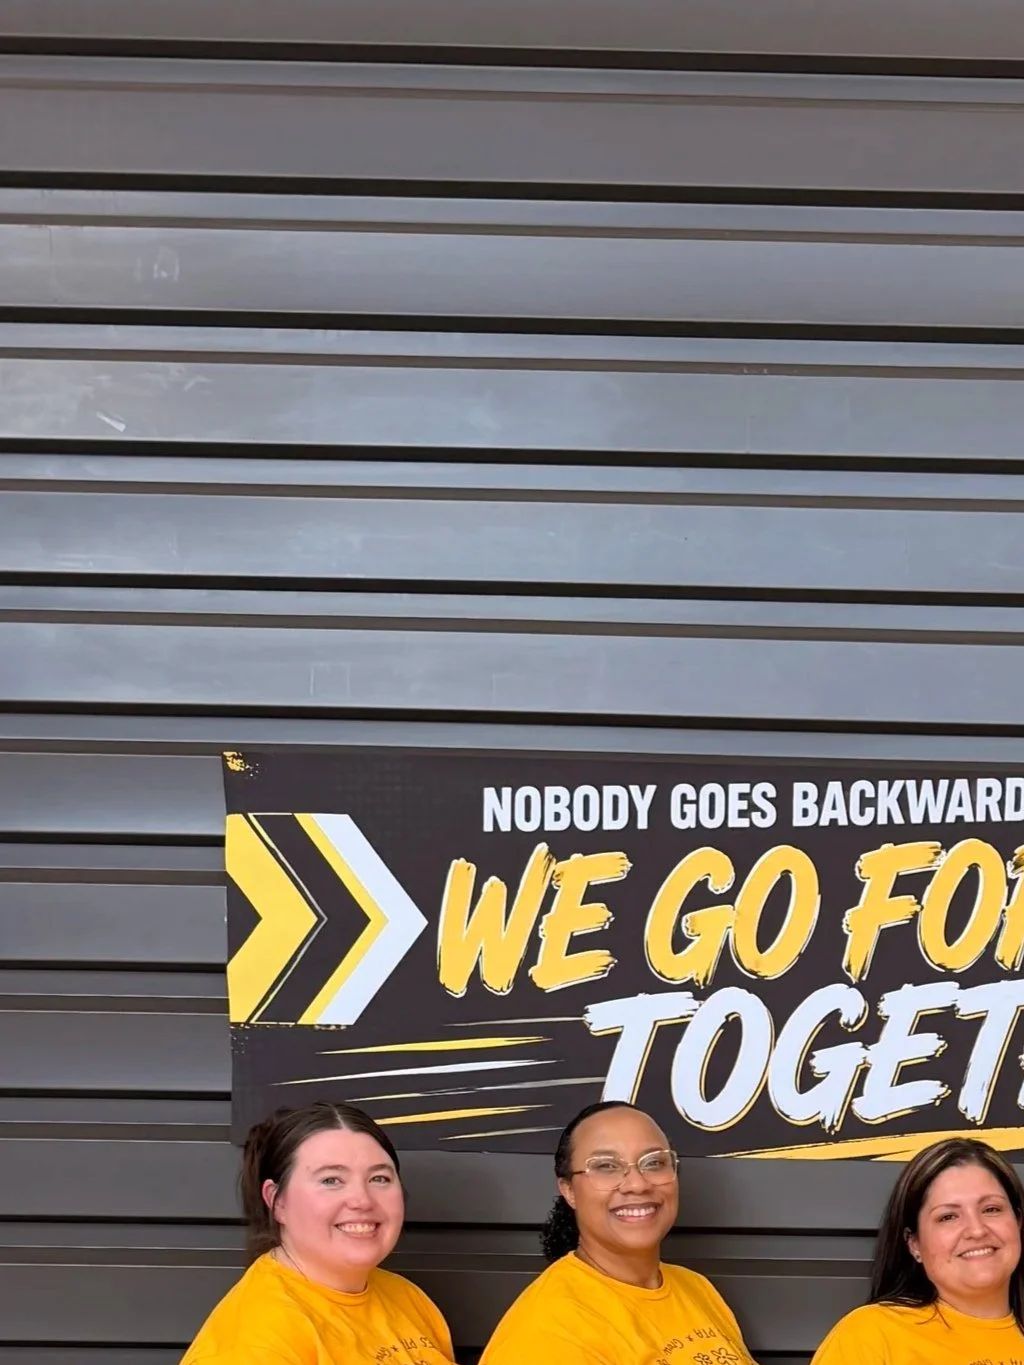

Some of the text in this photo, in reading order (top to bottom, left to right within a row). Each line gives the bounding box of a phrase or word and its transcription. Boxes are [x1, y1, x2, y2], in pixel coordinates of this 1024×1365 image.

[483, 784, 657, 832] NOBODY
[670, 782, 777, 830] GOES
[437, 842, 632, 997] WE
[644, 845, 820, 989] GO
[693, 1327, 717, 1339] PTA
